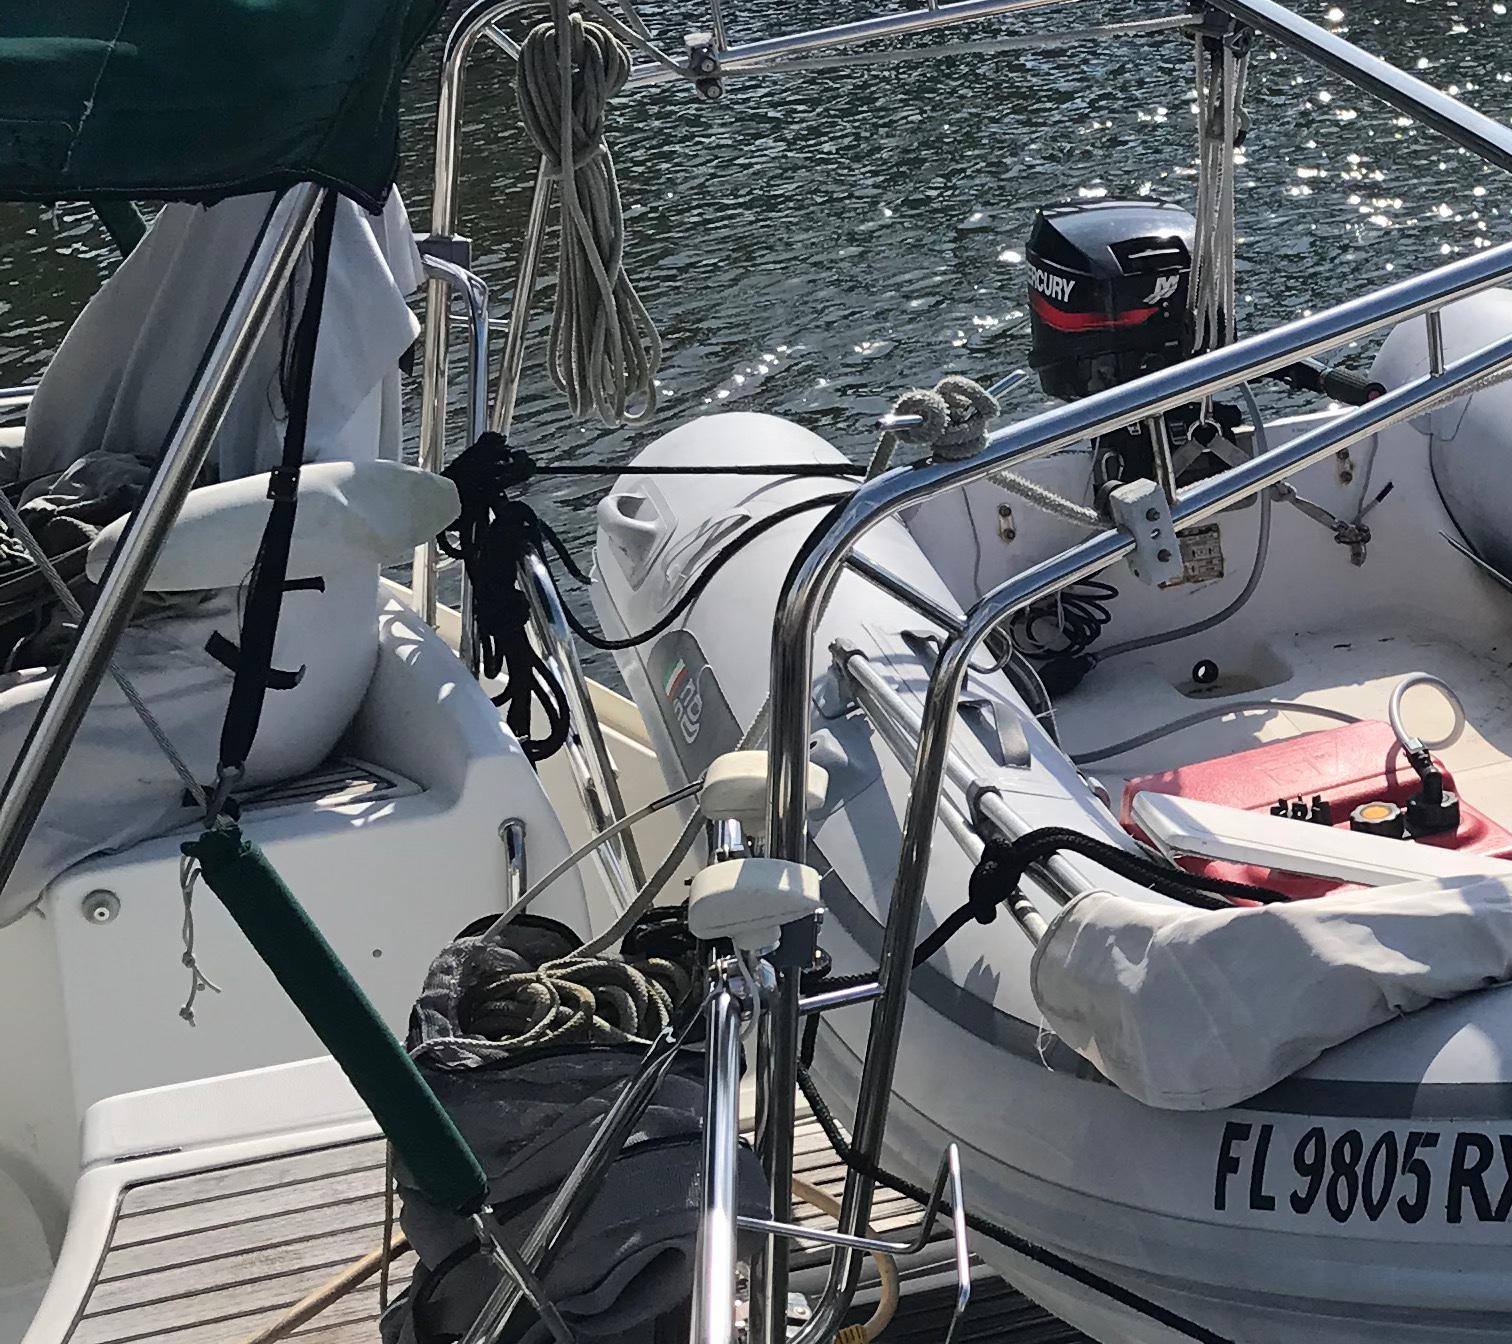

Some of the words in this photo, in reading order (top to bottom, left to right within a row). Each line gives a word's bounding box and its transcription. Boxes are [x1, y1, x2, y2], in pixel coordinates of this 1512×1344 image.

[1027, 264, 1076, 303] ERCURY
[1213, 1120, 1276, 1212] FL
[1288, 1125, 1441, 1225] 9805
